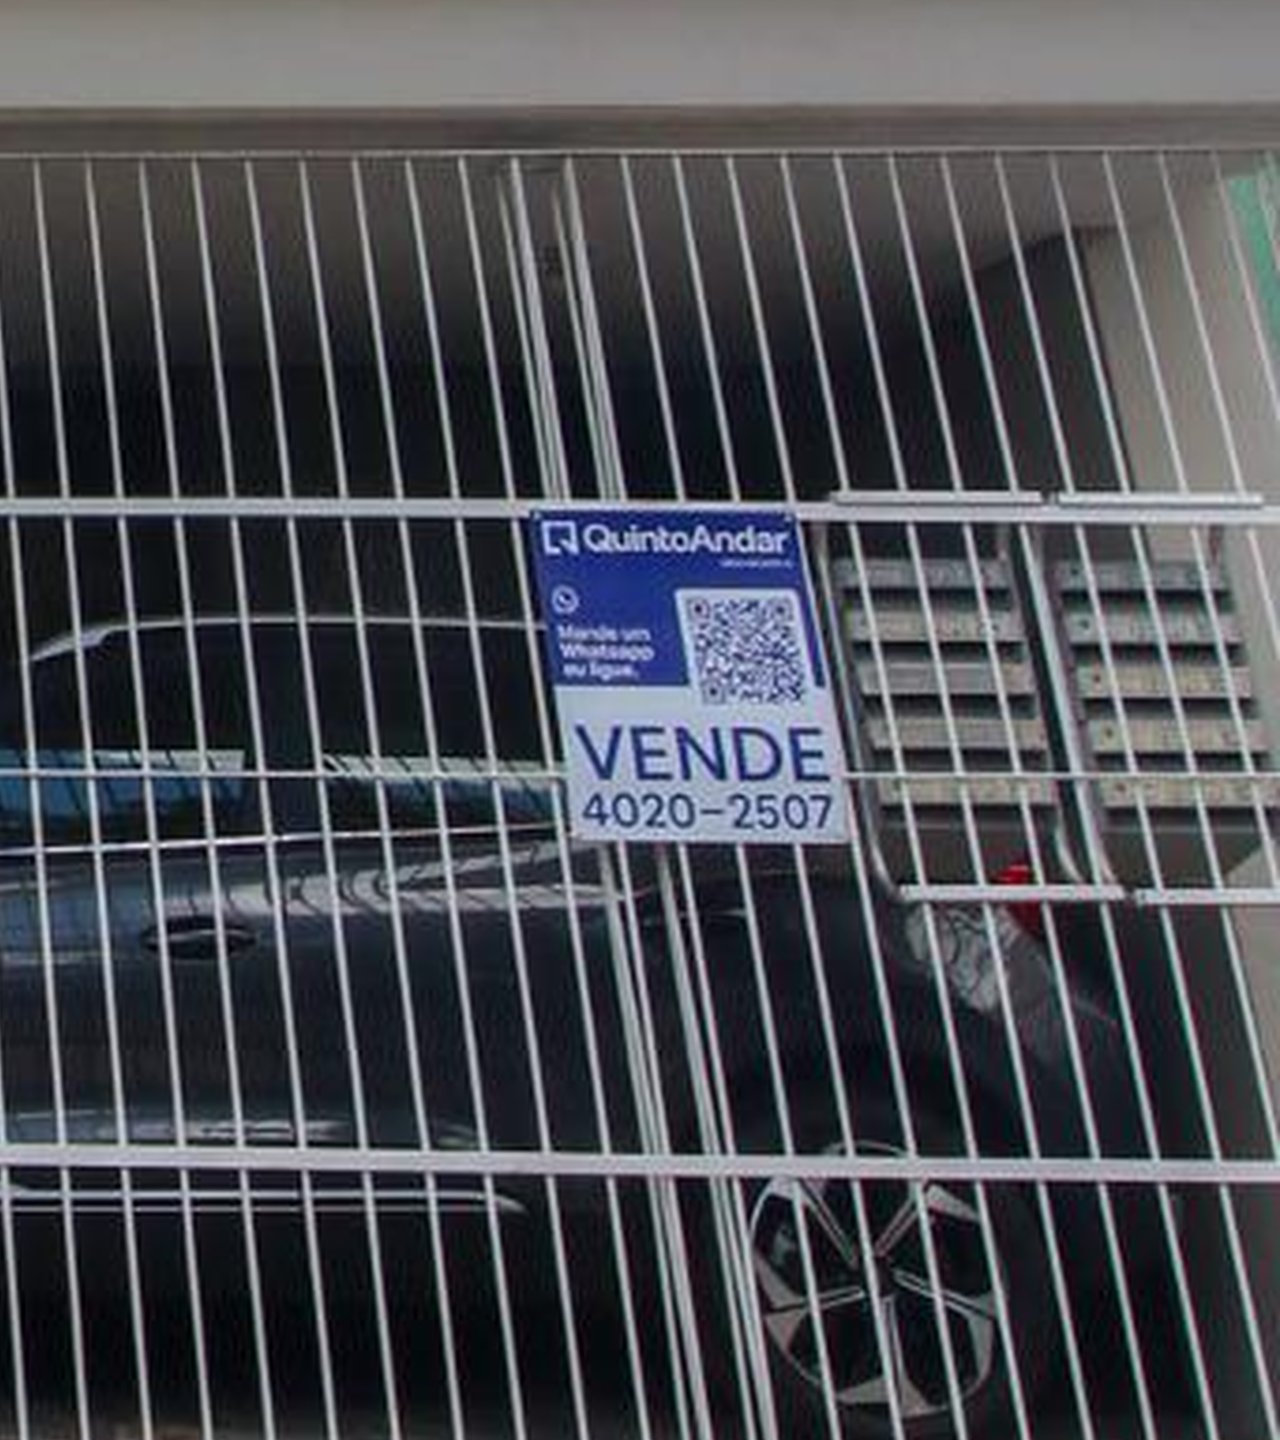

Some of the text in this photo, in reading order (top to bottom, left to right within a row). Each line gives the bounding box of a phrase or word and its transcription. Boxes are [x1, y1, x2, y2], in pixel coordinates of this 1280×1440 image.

[584, 523, 790, 556] QuintoAndar
[575, 724, 831, 782] VENDE
[582, 792, 833, 829] 4020-2507
